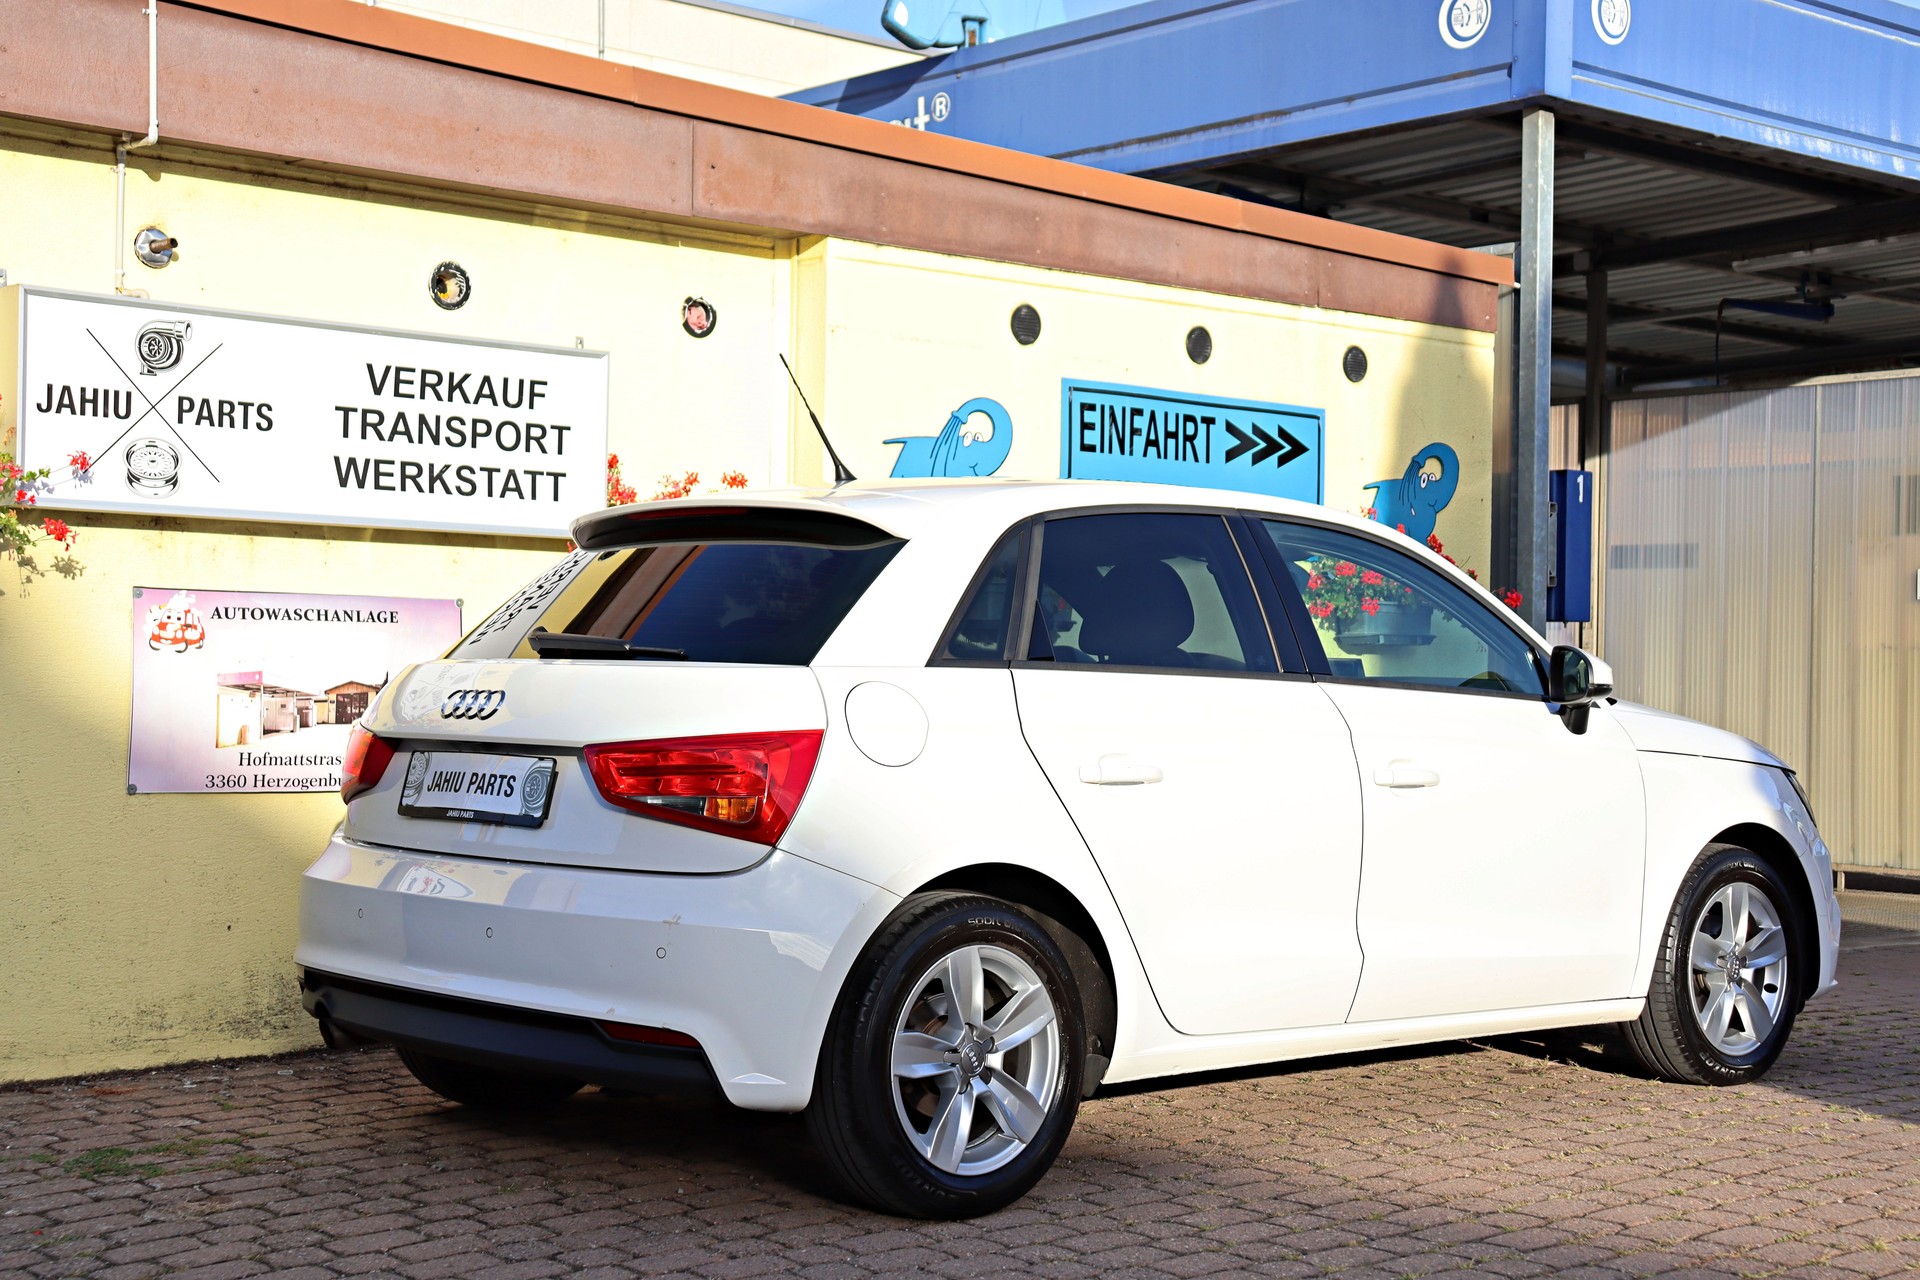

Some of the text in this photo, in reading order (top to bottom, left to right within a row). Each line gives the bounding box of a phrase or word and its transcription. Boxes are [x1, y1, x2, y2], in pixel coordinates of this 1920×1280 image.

[366, 363, 548, 410] VERKAUF
[36, 383, 274, 432] JAHIU PARTS
[334, 405, 571, 456] TRANSPORT
[1079, 402, 1217, 464] EINFAHRT
[333, 455, 567, 502] WERKSTATT
[1577, 474, 1584, 503] 1
[210, 605, 399, 625] AUTOWASCHANLAGE
[238, 752, 344, 767] Hofmattstras
[205, 774, 248, 789] 3360
[427, 770, 517, 798] JAHIU PARTS
[447, 809, 475, 818] JAHIU PARTS
